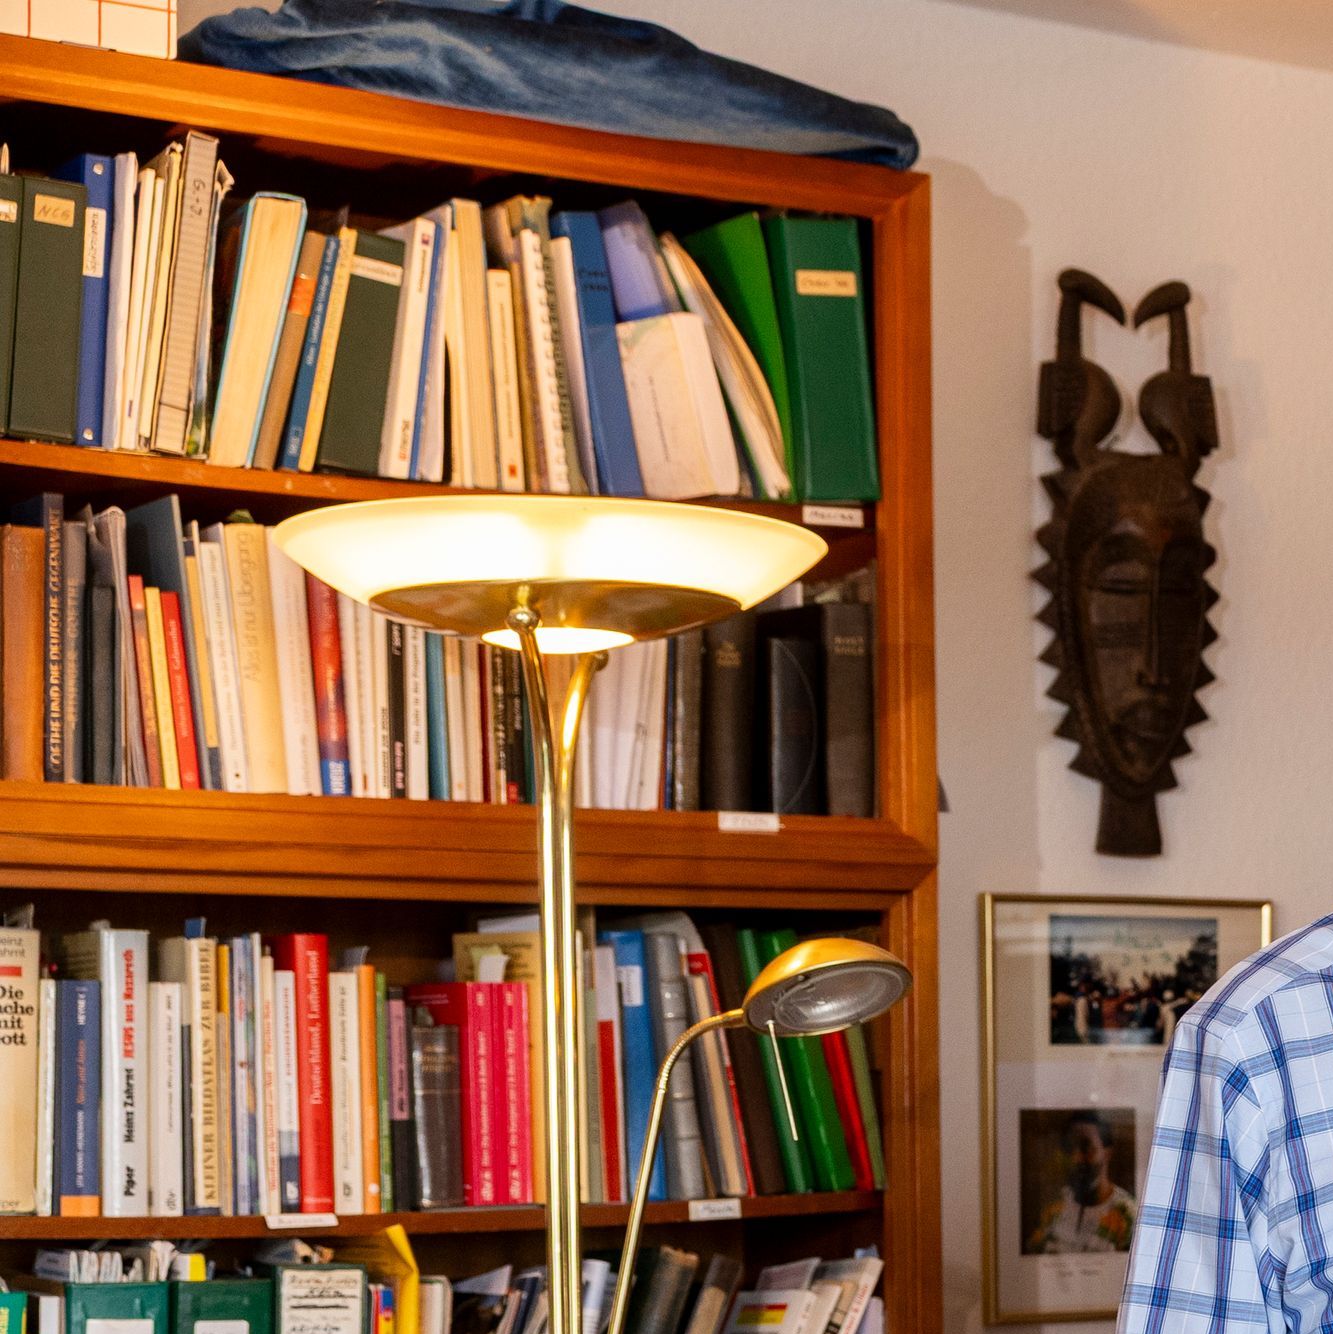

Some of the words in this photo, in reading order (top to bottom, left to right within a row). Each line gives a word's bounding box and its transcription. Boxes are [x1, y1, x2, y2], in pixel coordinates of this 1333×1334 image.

[49, 508, 60, 591] GEGENWART
[226, 529, 262, 607] Übergang
[50, 595, 60, 660] DEUTSCHE
[241, 609, 259, 632] nur
[245, 634, 258, 649] ist
[243, 650, 263, 683] Alles
[122, 949, 134, 1000] Nazareth
[198, 943, 210, 993] BIBEL
[305, 950, 321, 1019] Lutherland
[124, 1004, 134, 1022] aus
[200, 1000, 212, 1031] ZUR
[0, 1031, 27, 1046] ott
[124, 1028, 135, 1059] JESUS
[201, 1039, 214, 1126] BILDATLAS
[307, 1023, 324, 1105] Deutschland,
[123, 1068, 135, 1108] Zahrnt
[124, 1111, 135, 1142] Heinz
[124, 1166, 135, 1196] Piper
[201, 1133, 216, 1200] KLEINER
